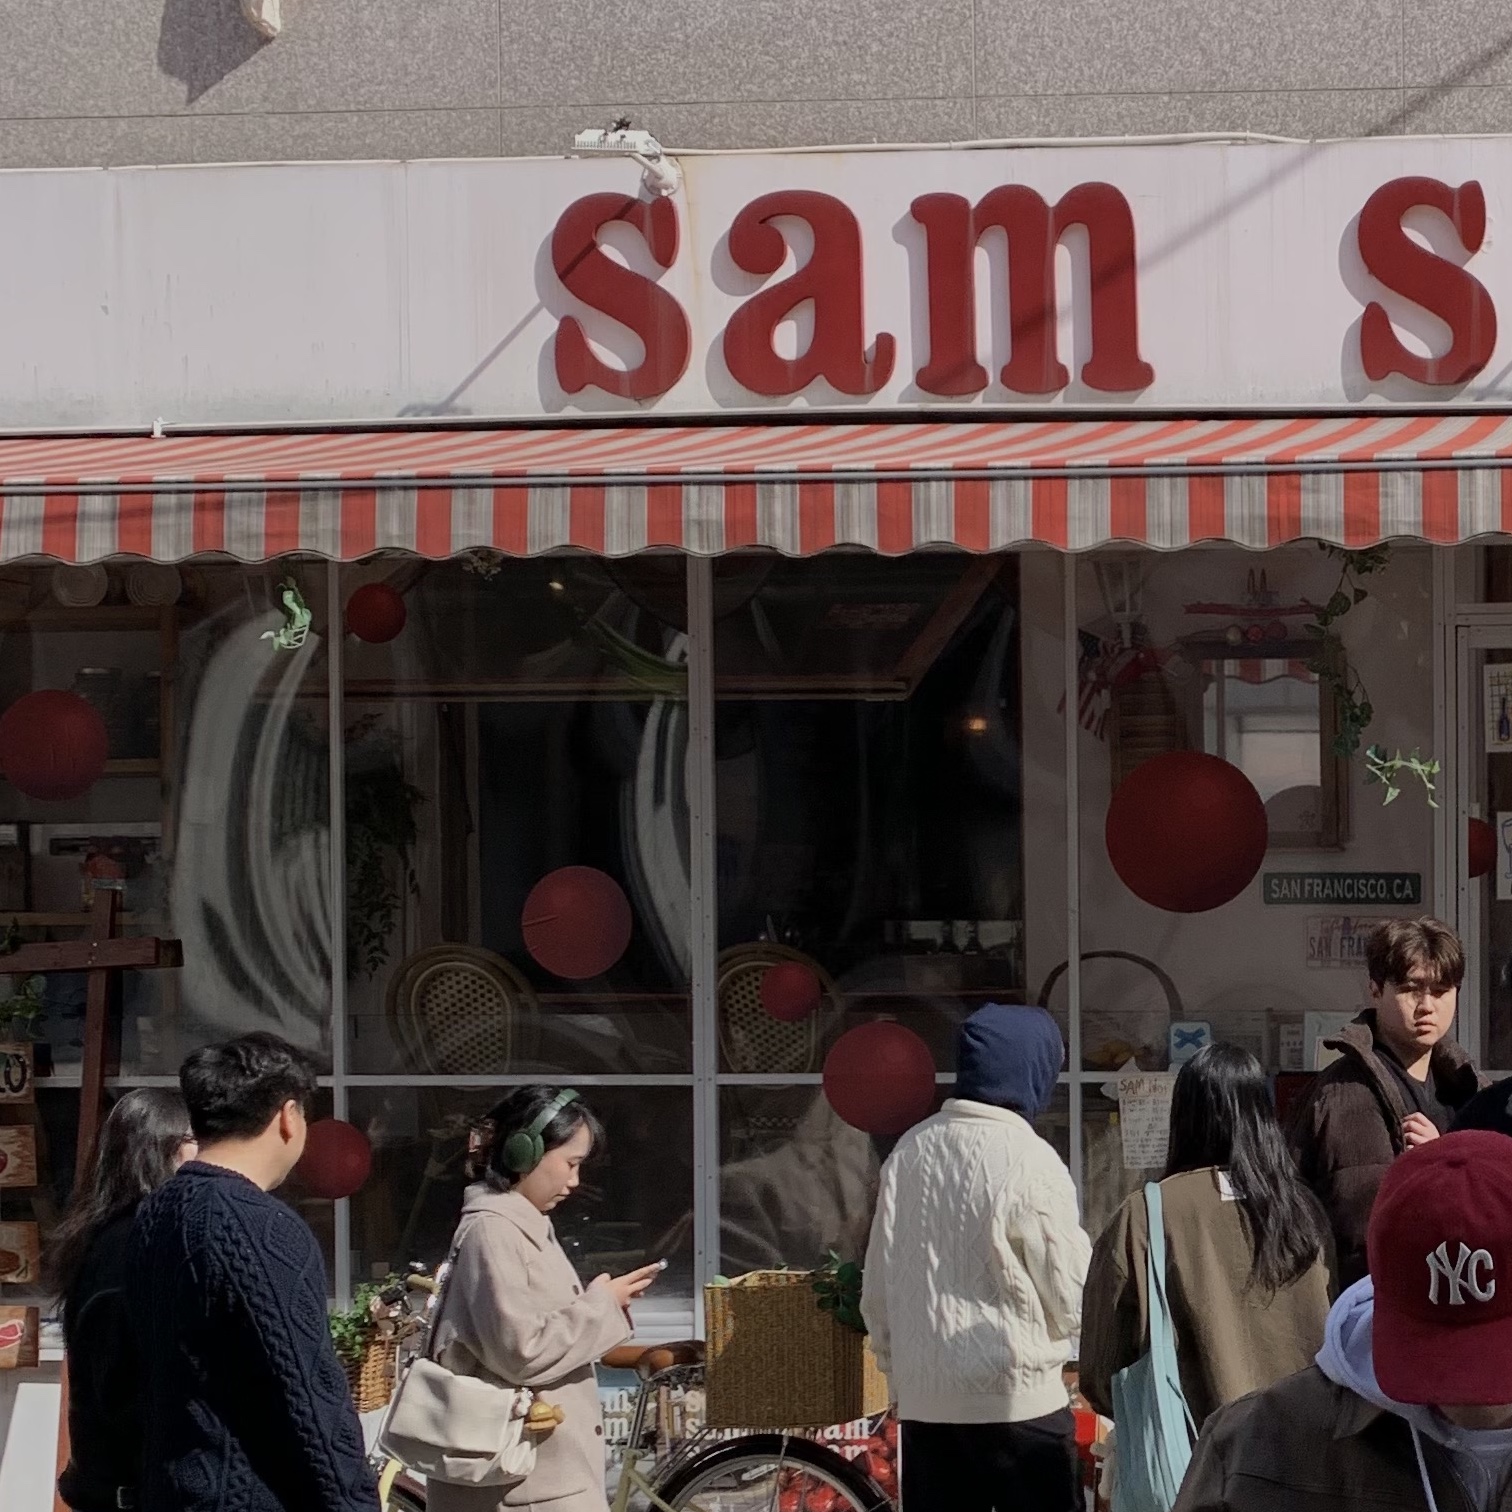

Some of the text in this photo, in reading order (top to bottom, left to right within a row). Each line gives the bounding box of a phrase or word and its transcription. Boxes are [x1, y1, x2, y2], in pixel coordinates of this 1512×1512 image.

[550, 191, 1154, 397] sam
[1271, 878, 1301, 899] SAN
[1393, 878, 1414, 899] CA
[1309, 936, 1332, 958] SAN
[1425, 1241, 1496, 1306] NYC
